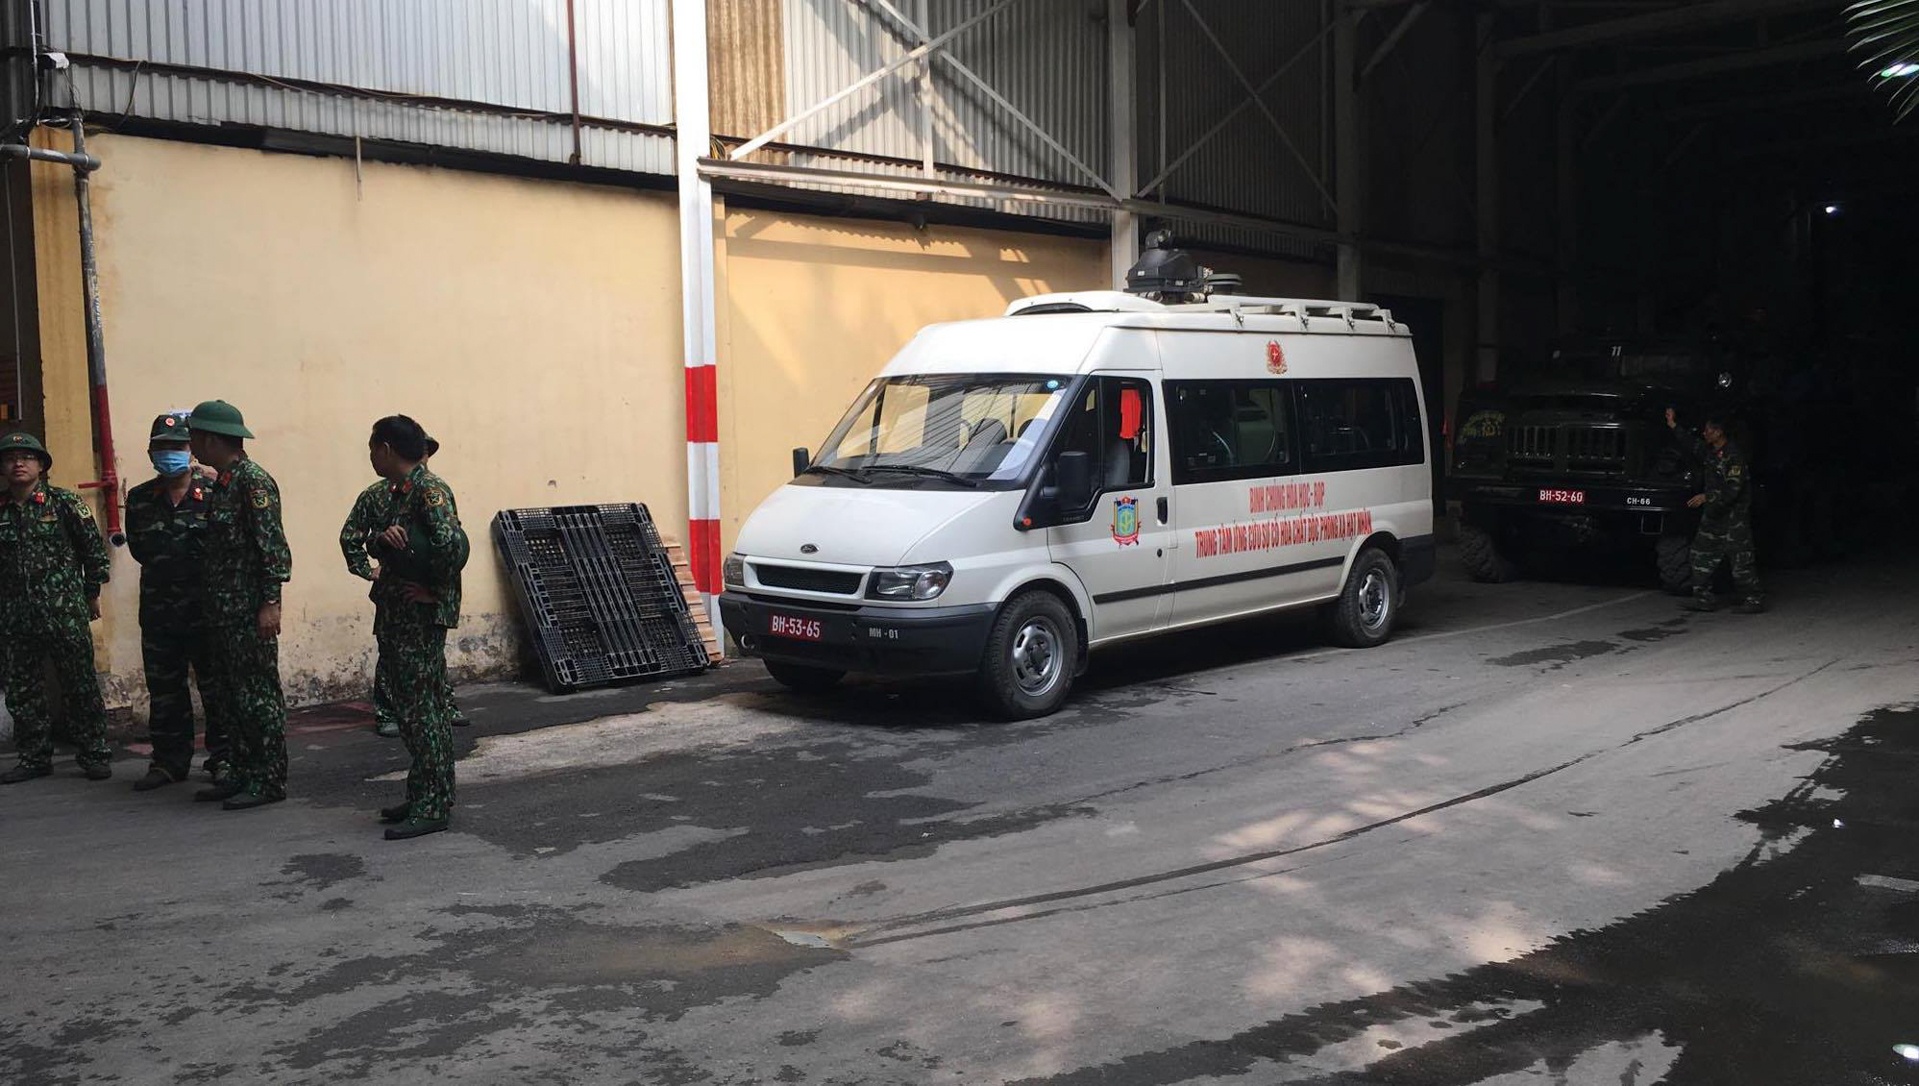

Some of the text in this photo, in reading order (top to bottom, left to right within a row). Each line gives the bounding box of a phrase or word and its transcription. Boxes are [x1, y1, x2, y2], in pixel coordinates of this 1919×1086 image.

[1540, 490, 1583, 502] BH-52-60
[1195, 529, 1218, 559] TRUNG
[1218, 523, 1233, 555] TÂM
[772, 616, 821, 639] BH-53-65
